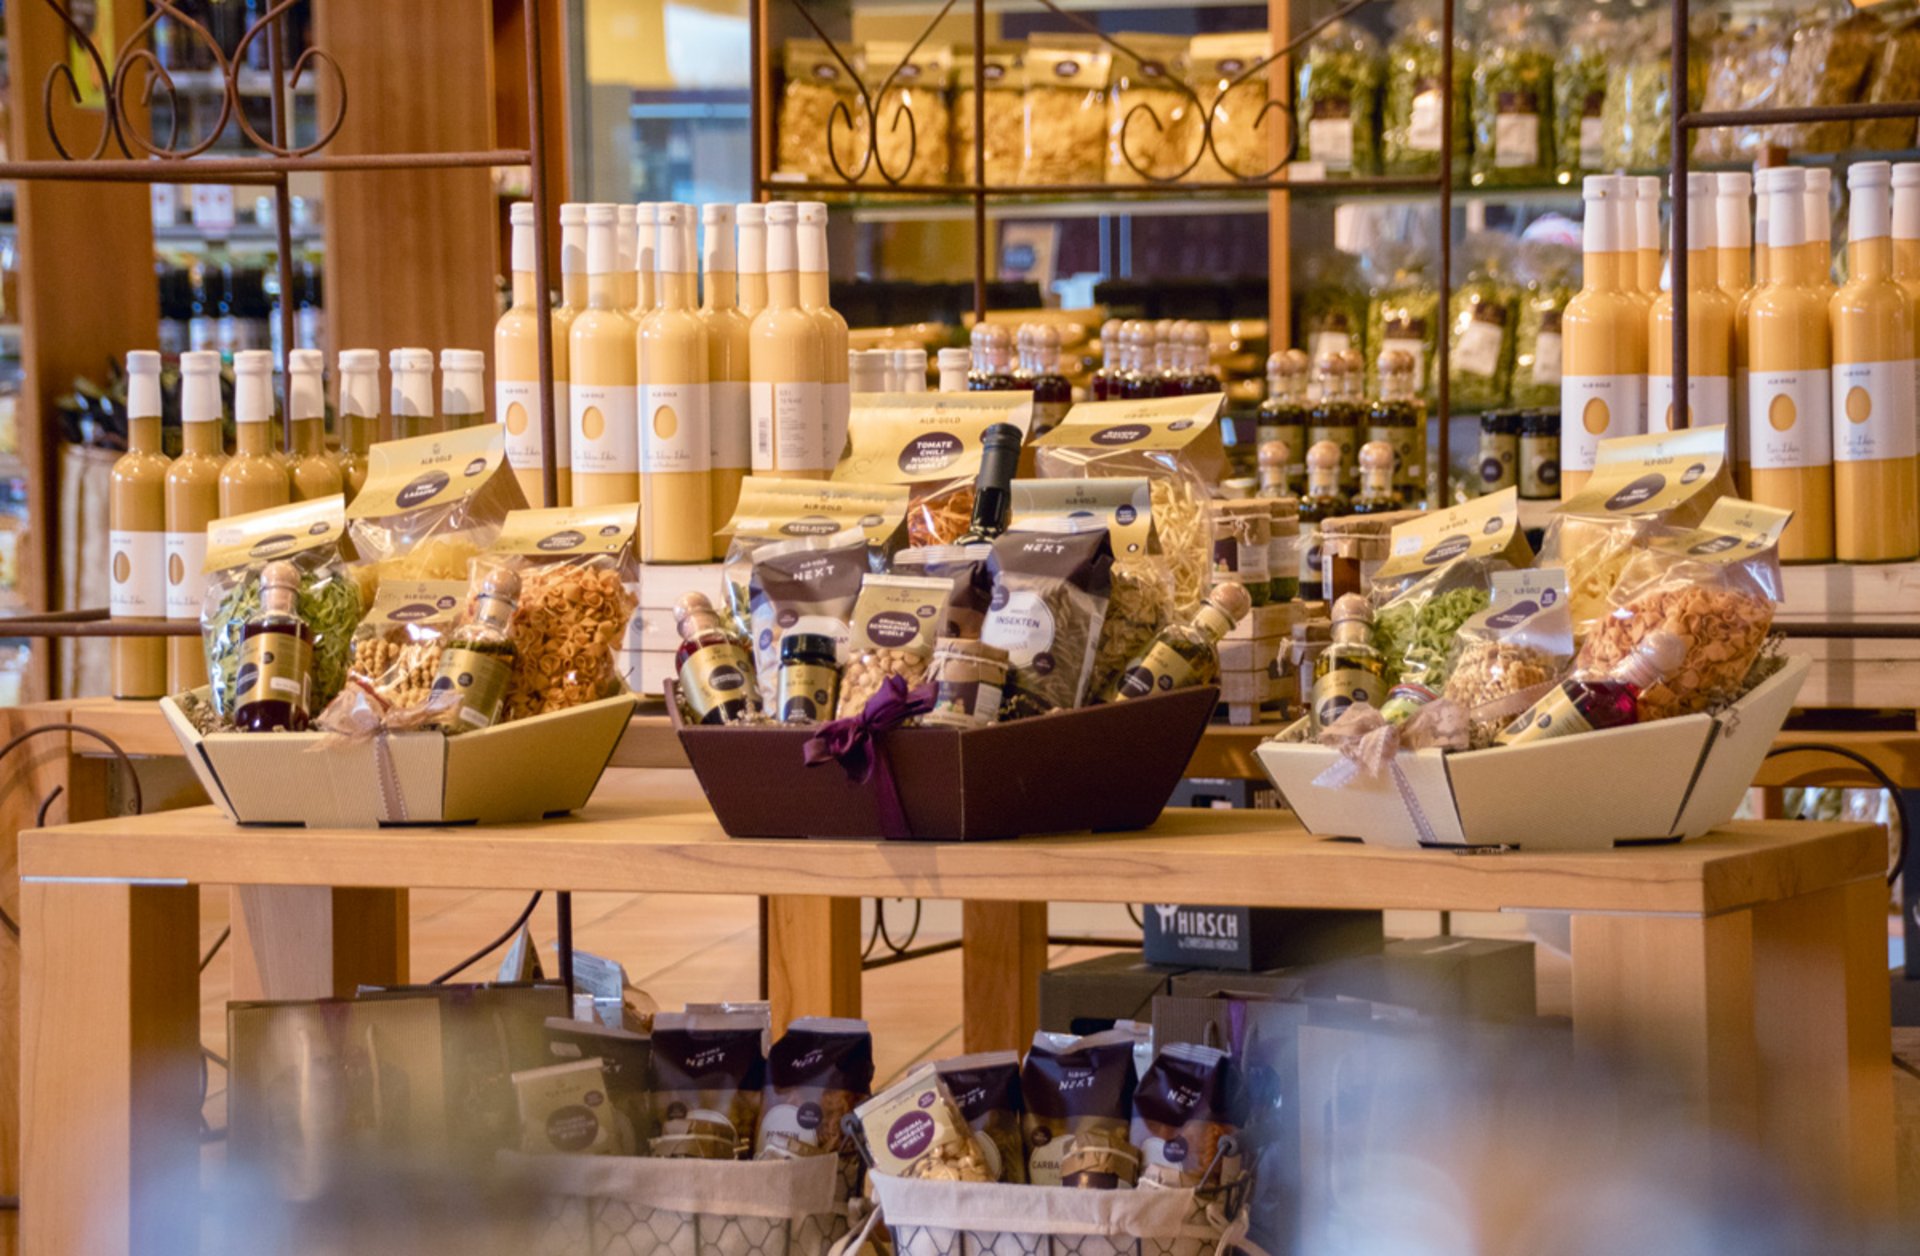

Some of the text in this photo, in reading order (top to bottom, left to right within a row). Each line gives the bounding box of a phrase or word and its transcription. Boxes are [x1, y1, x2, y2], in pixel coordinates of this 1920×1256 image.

[917, 440, 953, 449] TOMATE
[1023, 543, 1065, 555] NEXT
[793, 565, 835, 581] NEXT
[996, 616, 1040, 629] INSEKTEN
[1178, 911, 1238, 937] HIRSCH
[686, 1052, 726, 1067] NEXT
[792, 1054, 823, 1067] NEXT
[1059, 1076, 1095, 1091] NEXT
